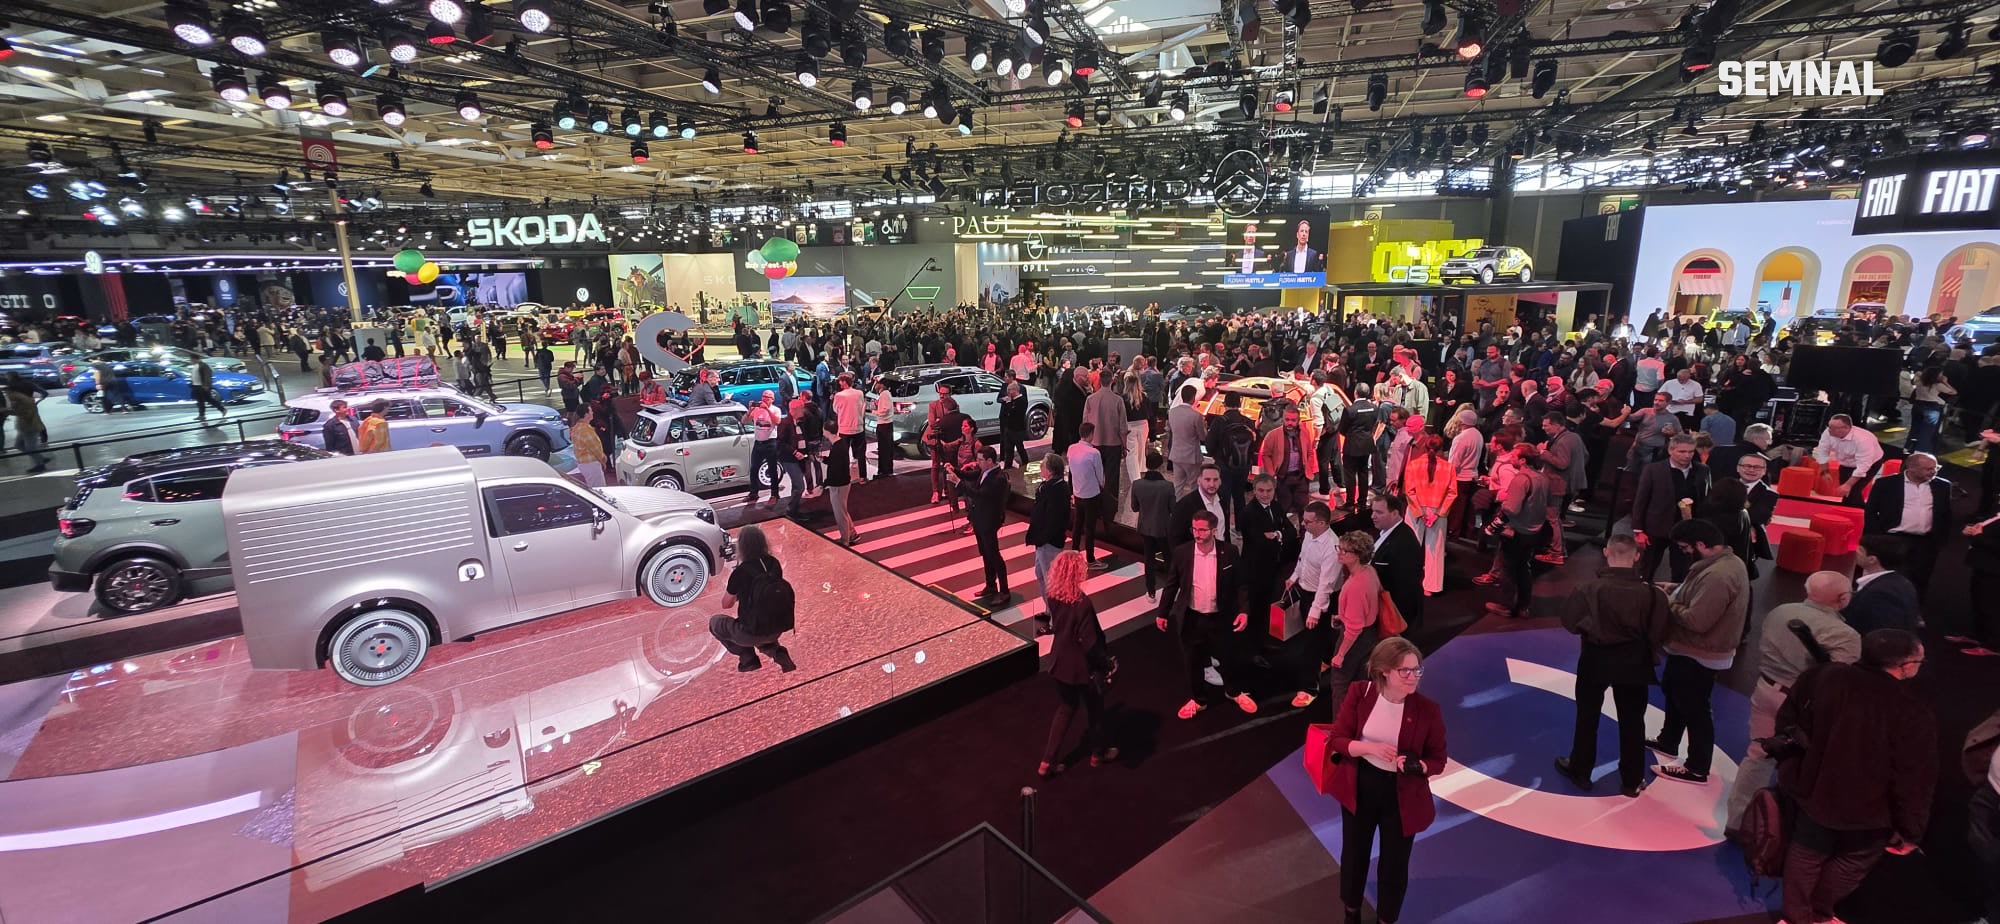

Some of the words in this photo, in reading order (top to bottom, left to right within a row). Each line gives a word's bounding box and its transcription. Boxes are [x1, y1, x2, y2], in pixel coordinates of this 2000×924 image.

[1862, 173, 1907, 218] FIAT
[1920, 168, 2000, 214] FIAT
[951, 215, 1012, 234] PAUL
[1022, 264, 1049, 272] OPEL
[0, 294, 31, 309] GTI
